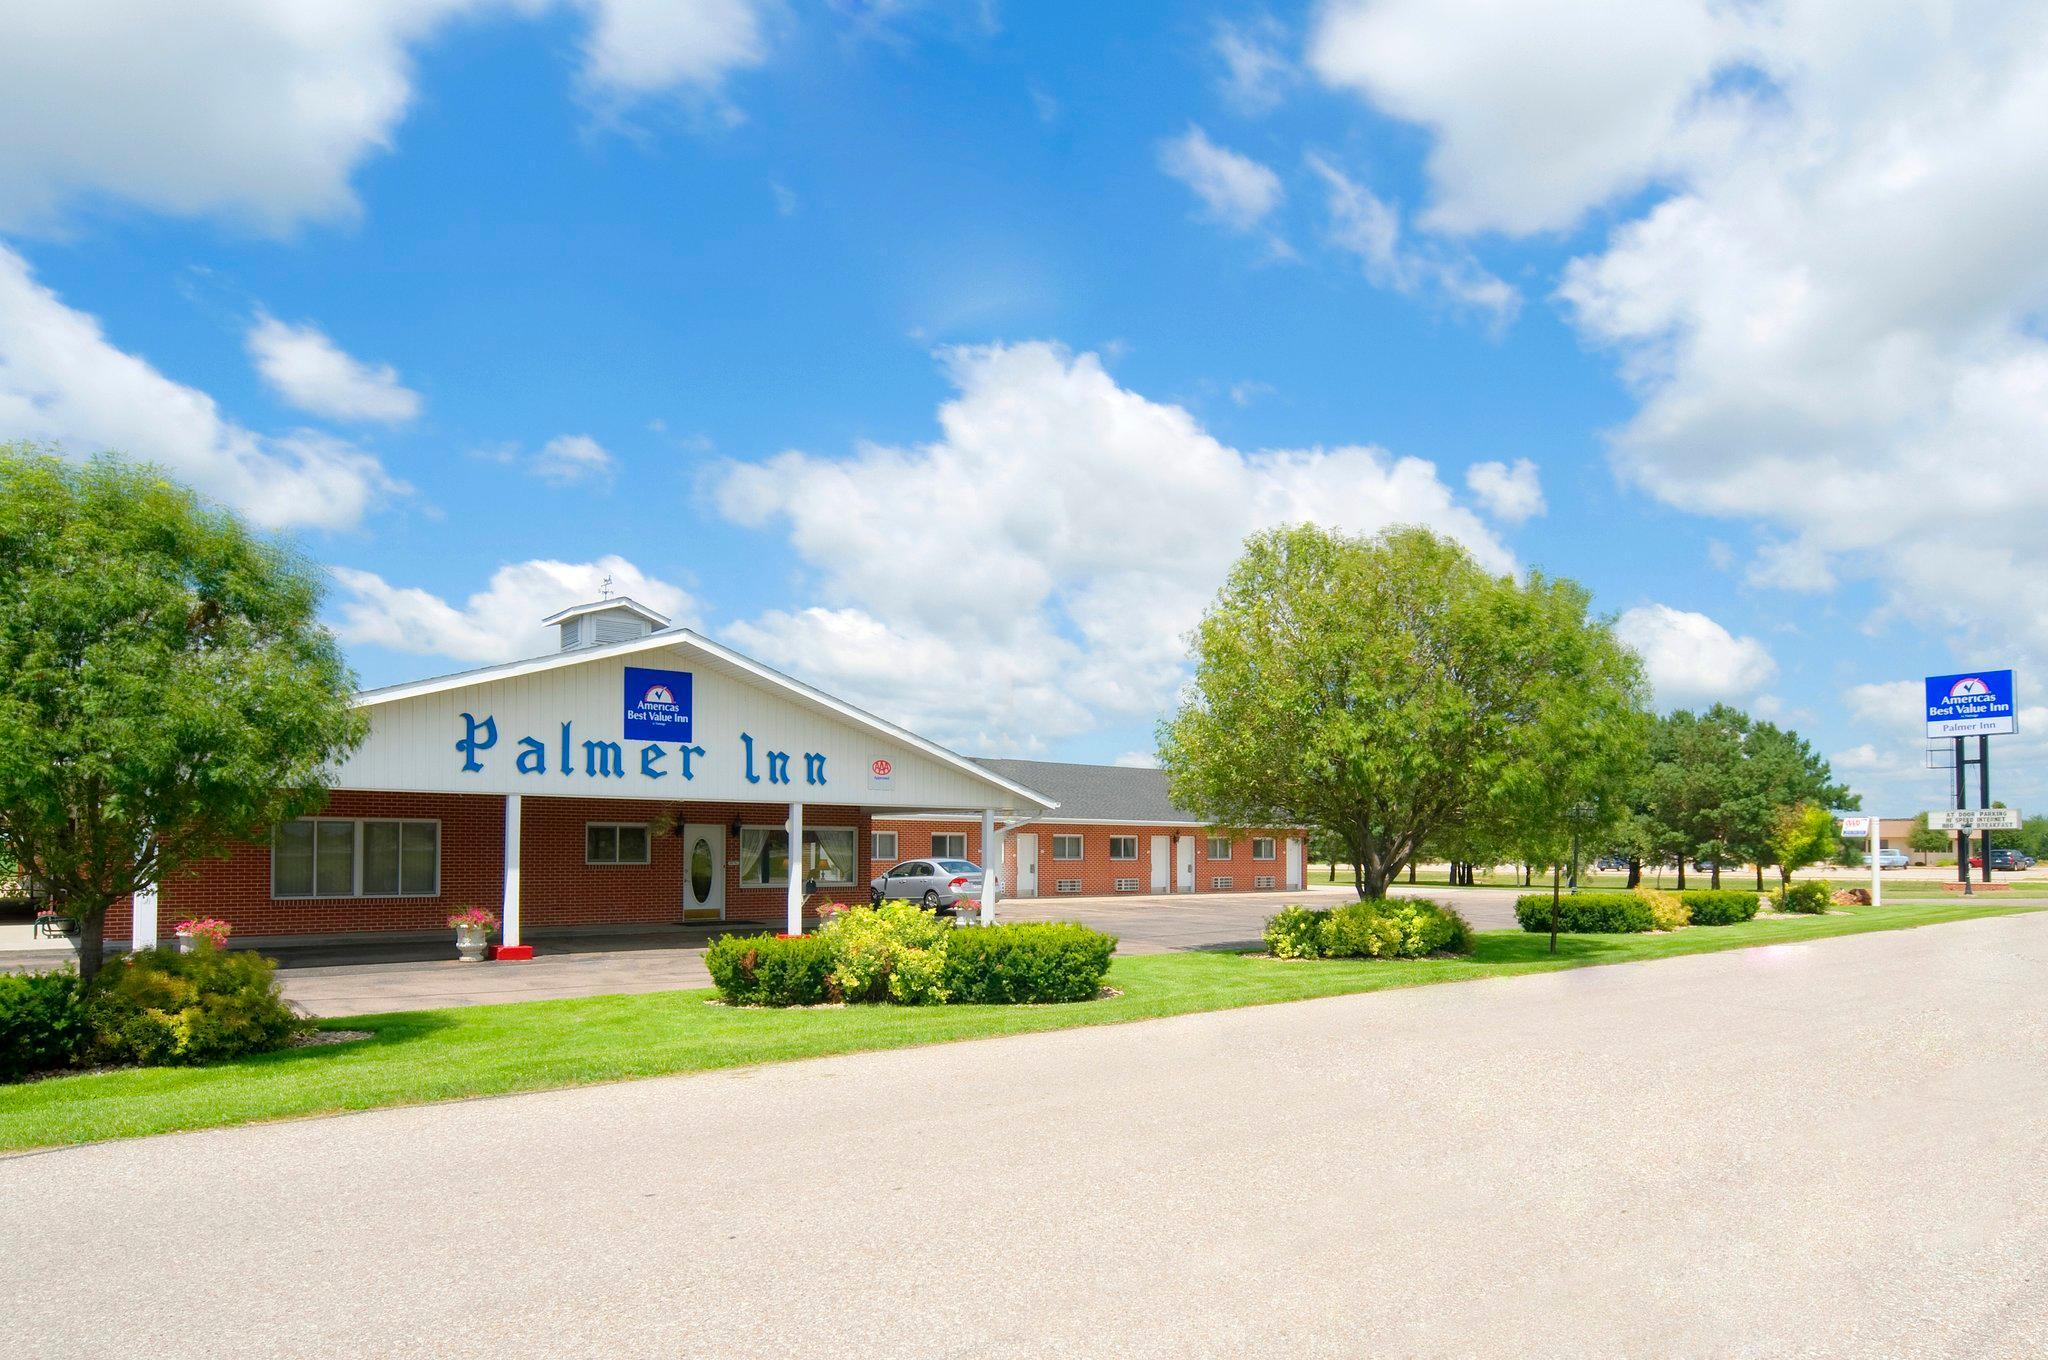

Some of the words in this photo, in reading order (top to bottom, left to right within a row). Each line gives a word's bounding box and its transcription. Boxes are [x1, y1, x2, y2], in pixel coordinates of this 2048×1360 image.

[637, 700, 680, 712] Americas
[1941, 694, 1996, 705] Americas
[1929, 706, 1953, 716] Best
[1955, 703, 1988, 714] Value
[1989, 702, 2009, 712] Inn
[627, 709, 647, 721] Best
[649, 711, 673, 722] Value
[674, 713, 689, 723] Inn
[1943, 723, 1977, 732] Palmer
[1980, 721, 1996, 729] Inn
[455, 712, 706, 782] Palmer
[740, 731, 828, 786] Inn
